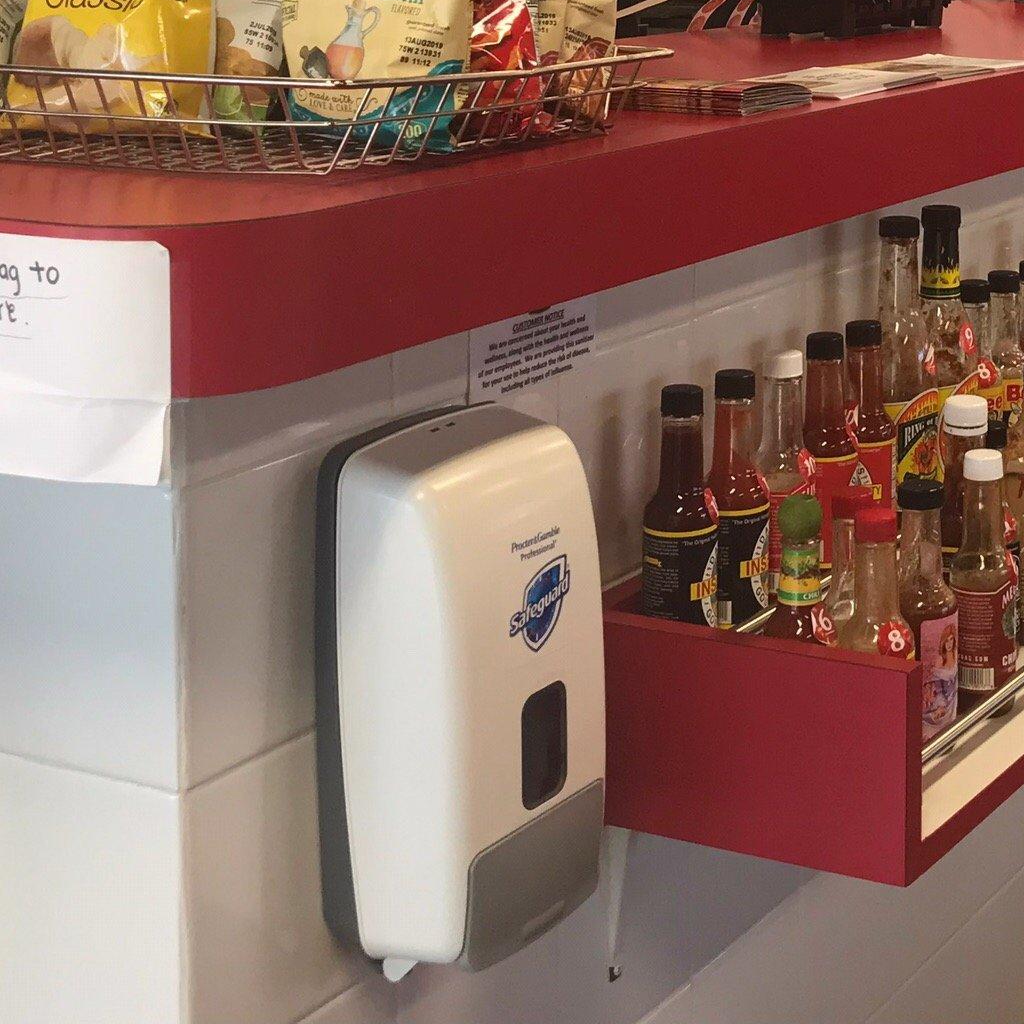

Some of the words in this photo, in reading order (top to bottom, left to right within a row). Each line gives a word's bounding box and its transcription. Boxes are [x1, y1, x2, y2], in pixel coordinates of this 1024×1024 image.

[390, 3, 422, 16] FLAVORED
[412, 57, 432, 67] 11:12
[308, 90, 330, 101] made
[308, 99, 328, 110] LOVE
[336, 103, 352, 113] CARE
[29, 261, 60, 285] to
[512, 314, 544, 334] CUSTOMER
[544, 309, 565, 324] NOTICE
[488, 343, 498, 352] We
[507, 332, 534, 347] concerned
[534, 327, 549, 340] about
[561, 318, 576, 329] health
[508, 347, 523, 359] along
[523, 343, 534, 353] with
[543, 334, 559, 346] health
[569, 326, 589, 337] wellness
[543, 344, 565, 358] providing
[565, 341, 575, 351] this
[490, 377, 503, 388] your
[519, 366, 531, 377] help
[531, 361, 548, 373] reduce
[557, 355, 566, 364] risk
[501, 381, 524, 394] including
[531, 373, 544, 386] types
[903, 421, 925, 448] RING
[510, 575, 569, 635] Safeguard
[888, 629, 905, 653] 8
